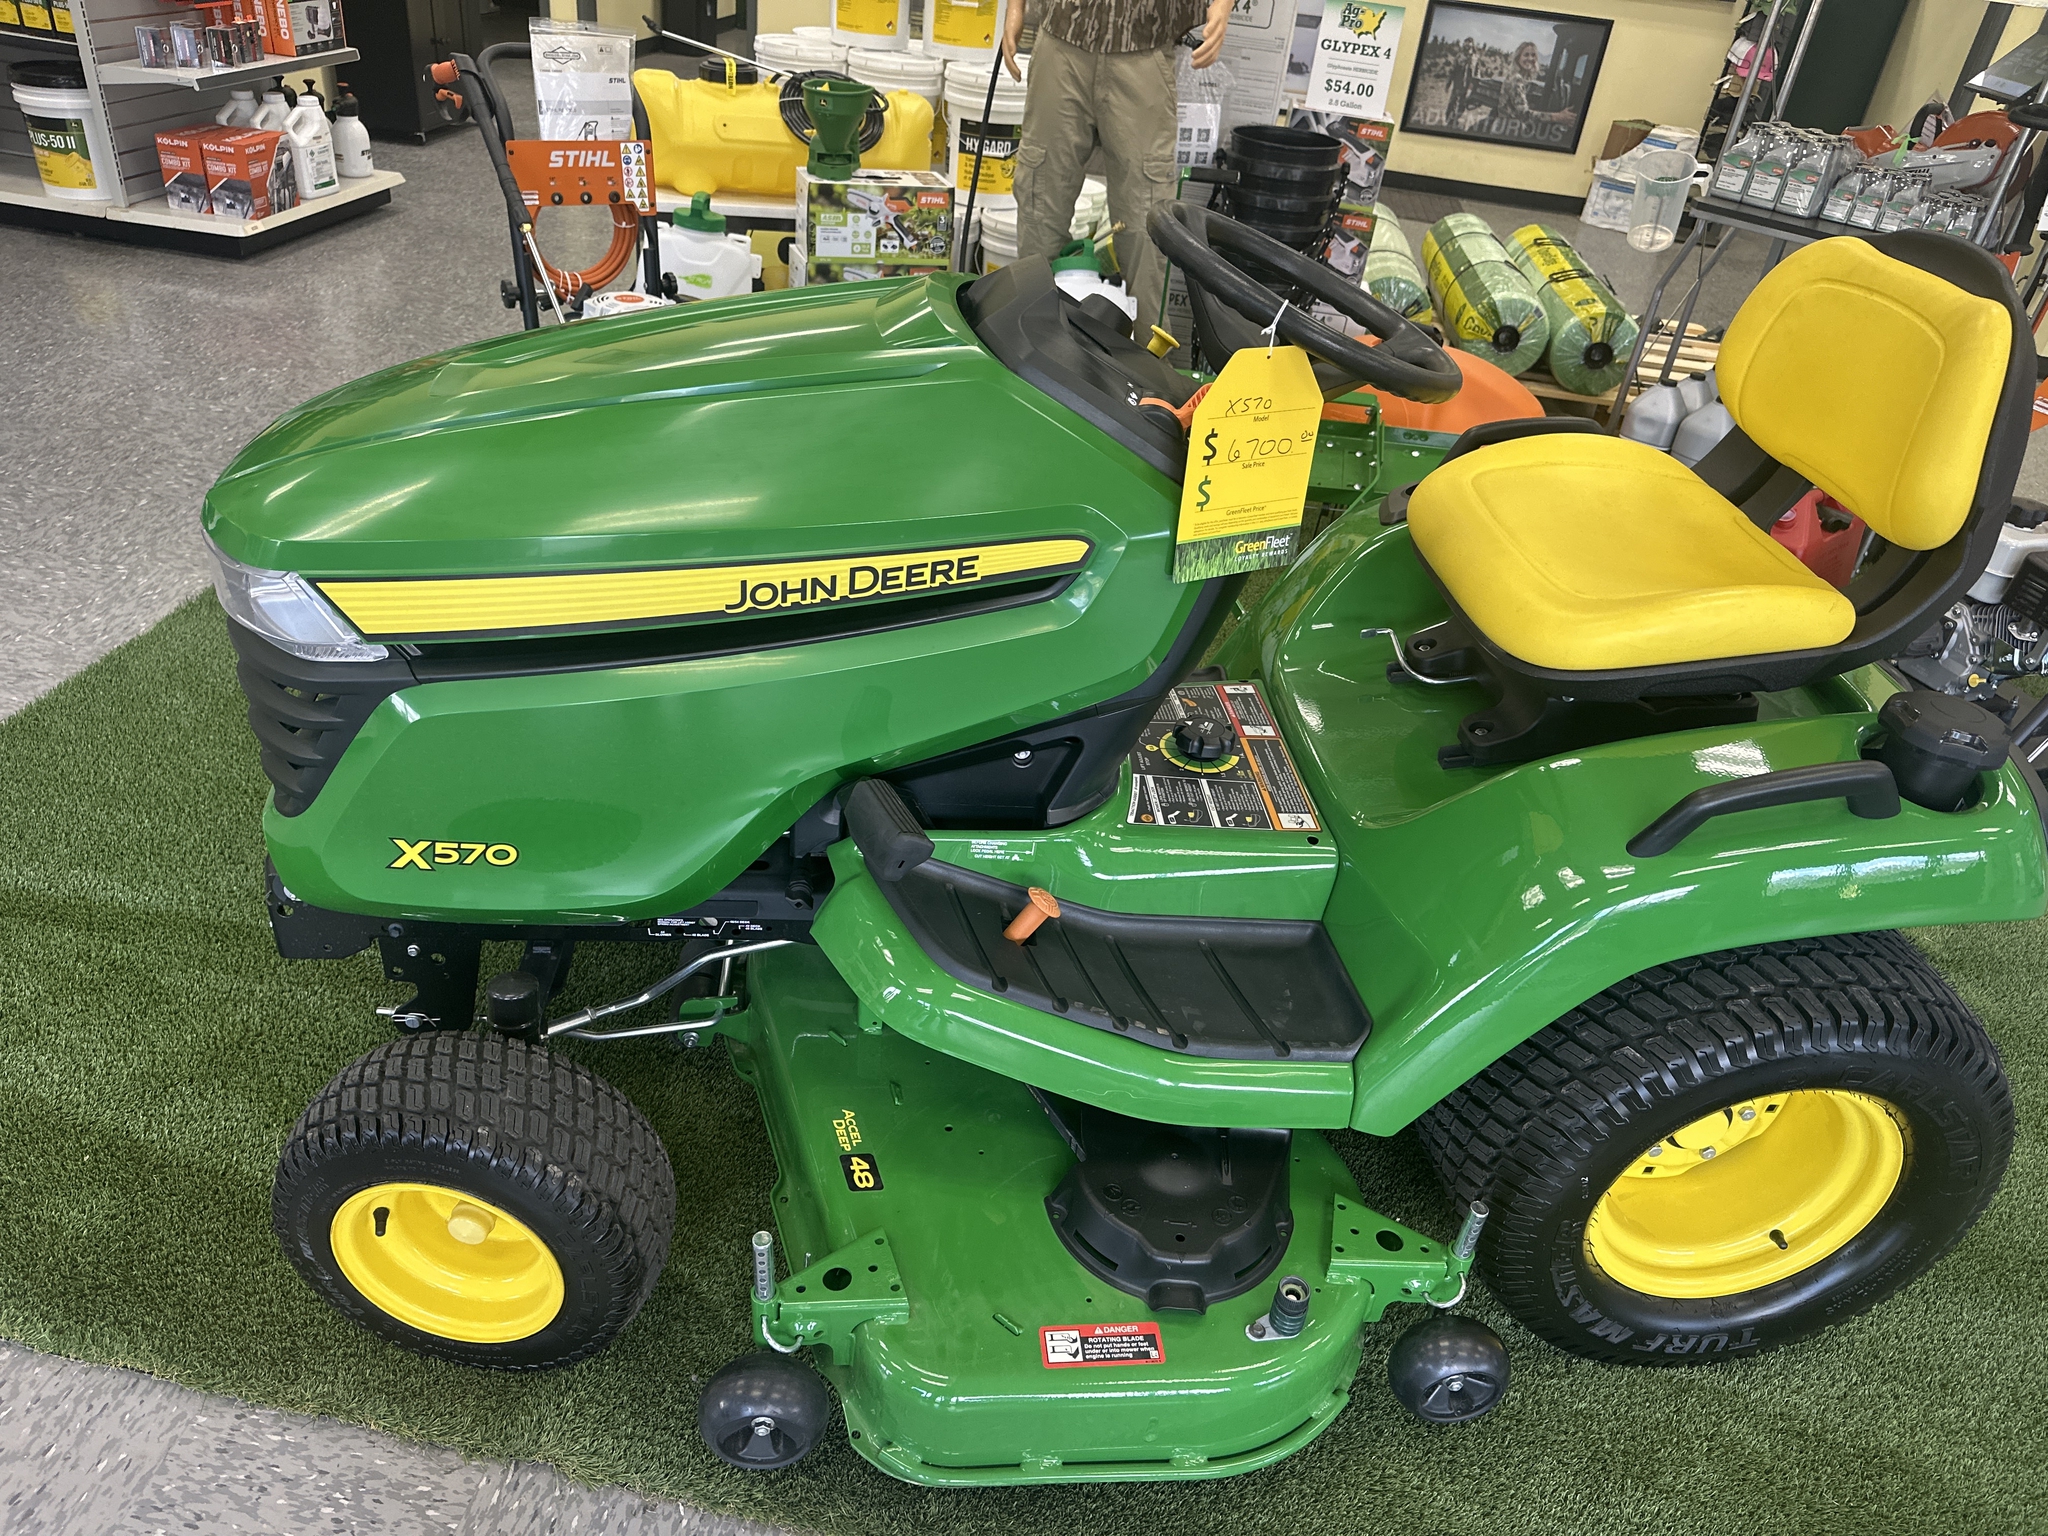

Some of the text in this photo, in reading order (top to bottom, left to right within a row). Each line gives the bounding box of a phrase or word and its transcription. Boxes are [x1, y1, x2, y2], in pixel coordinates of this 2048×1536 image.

[254, 0, 267, 37] NEBO
[1343, 3, 1365, 18] Ag-
[276, 0, 290, 40] NEBO
[1340, 15, 1363, 29] Pro
[1321, 38, 1392, 60] GLYPEX 4
[1324, 78, 1374, 97] $54.00
[1340, 100, 1363, 110] Gallon
[27, 129, 65, 149] PLUS-50
[1360, 128, 1384, 137] STIHL
[156, 137, 189, 148] KOLPIN
[202, 143, 235, 154] KOLPIN
[245, 143, 266, 154] KOLPIN
[549, 150, 615, 168] STIHL
[920, 196, 946, 204] STIHL
[1345, 219, 1368, 228] STIHL
[1225, 397, 1272, 418] X570
[1253, 414, 1269, 423] Model
[1203, 428, 1218, 466] $
[1242, 460, 1265, 470] Sale Price
[1196, 475, 1211, 512] $
[1226, 508, 1252, 516] GreenFleet
[1235, 534, 1290, 554] GreenFleet
[1234, 549, 1288, 562] LOYALTY REWARDS
[725, 555, 980, 610] JOHN DEERE
[385, 837, 519, 871] X570
[832, 1119, 852, 1152] DEEP
[841, 1109, 863, 1147] ACCEL
[850, 1156, 875, 1188] 48
[1549, 1219, 1761, 1355] TURF MASTER
[1103, 1325, 1139, 1334] DANGER
